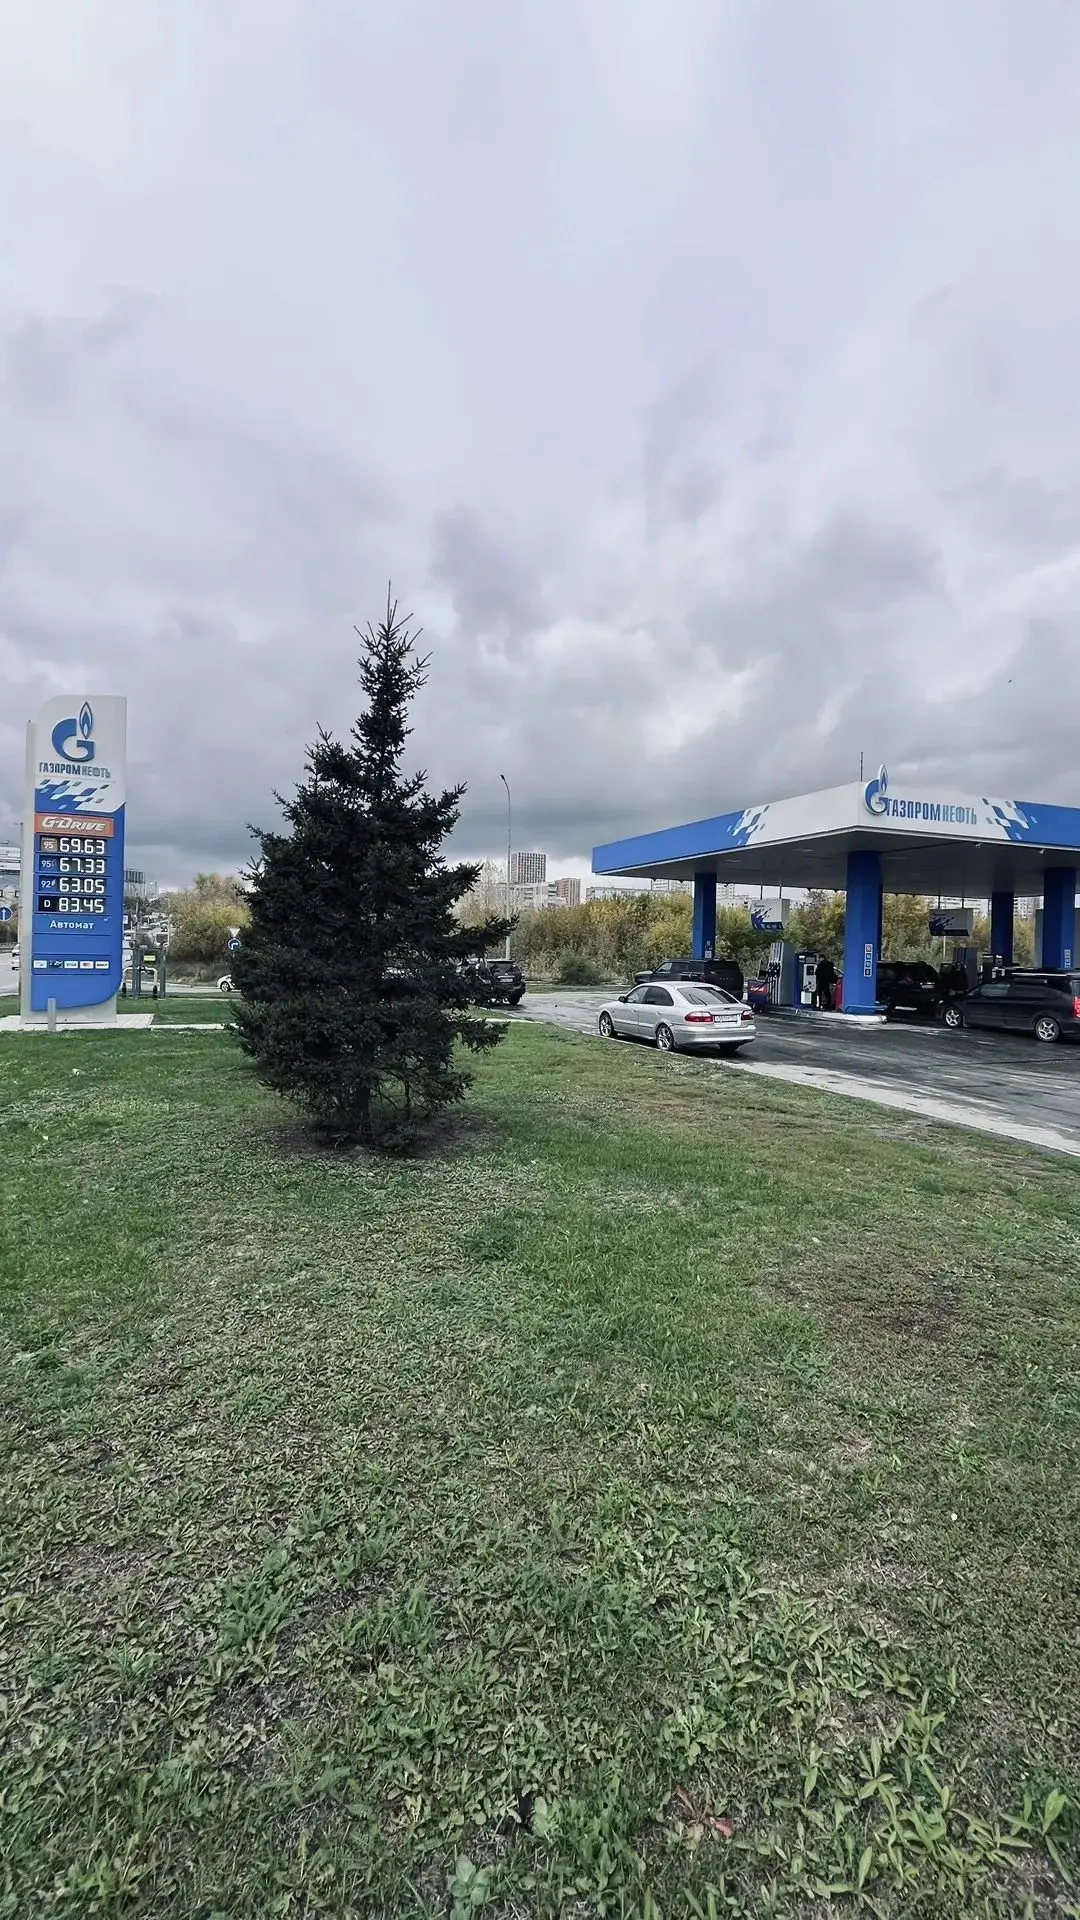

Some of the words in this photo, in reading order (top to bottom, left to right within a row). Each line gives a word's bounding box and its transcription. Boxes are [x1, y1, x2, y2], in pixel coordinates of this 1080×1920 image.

[886, 799, 977, 825] ГАЗПРОМНЕФТЬ
[43, 841, 54, 849] 95
[59, 838, 105, 854] 69.63
[41, 860, 51, 868] 95
[59, 858, 105, 874] 67.33
[41, 880, 51, 888] 92
[59, 878, 105, 894] 63.05
[58, 898, 104, 914] 83.45
[49, 920, 94, 929] Автомат
